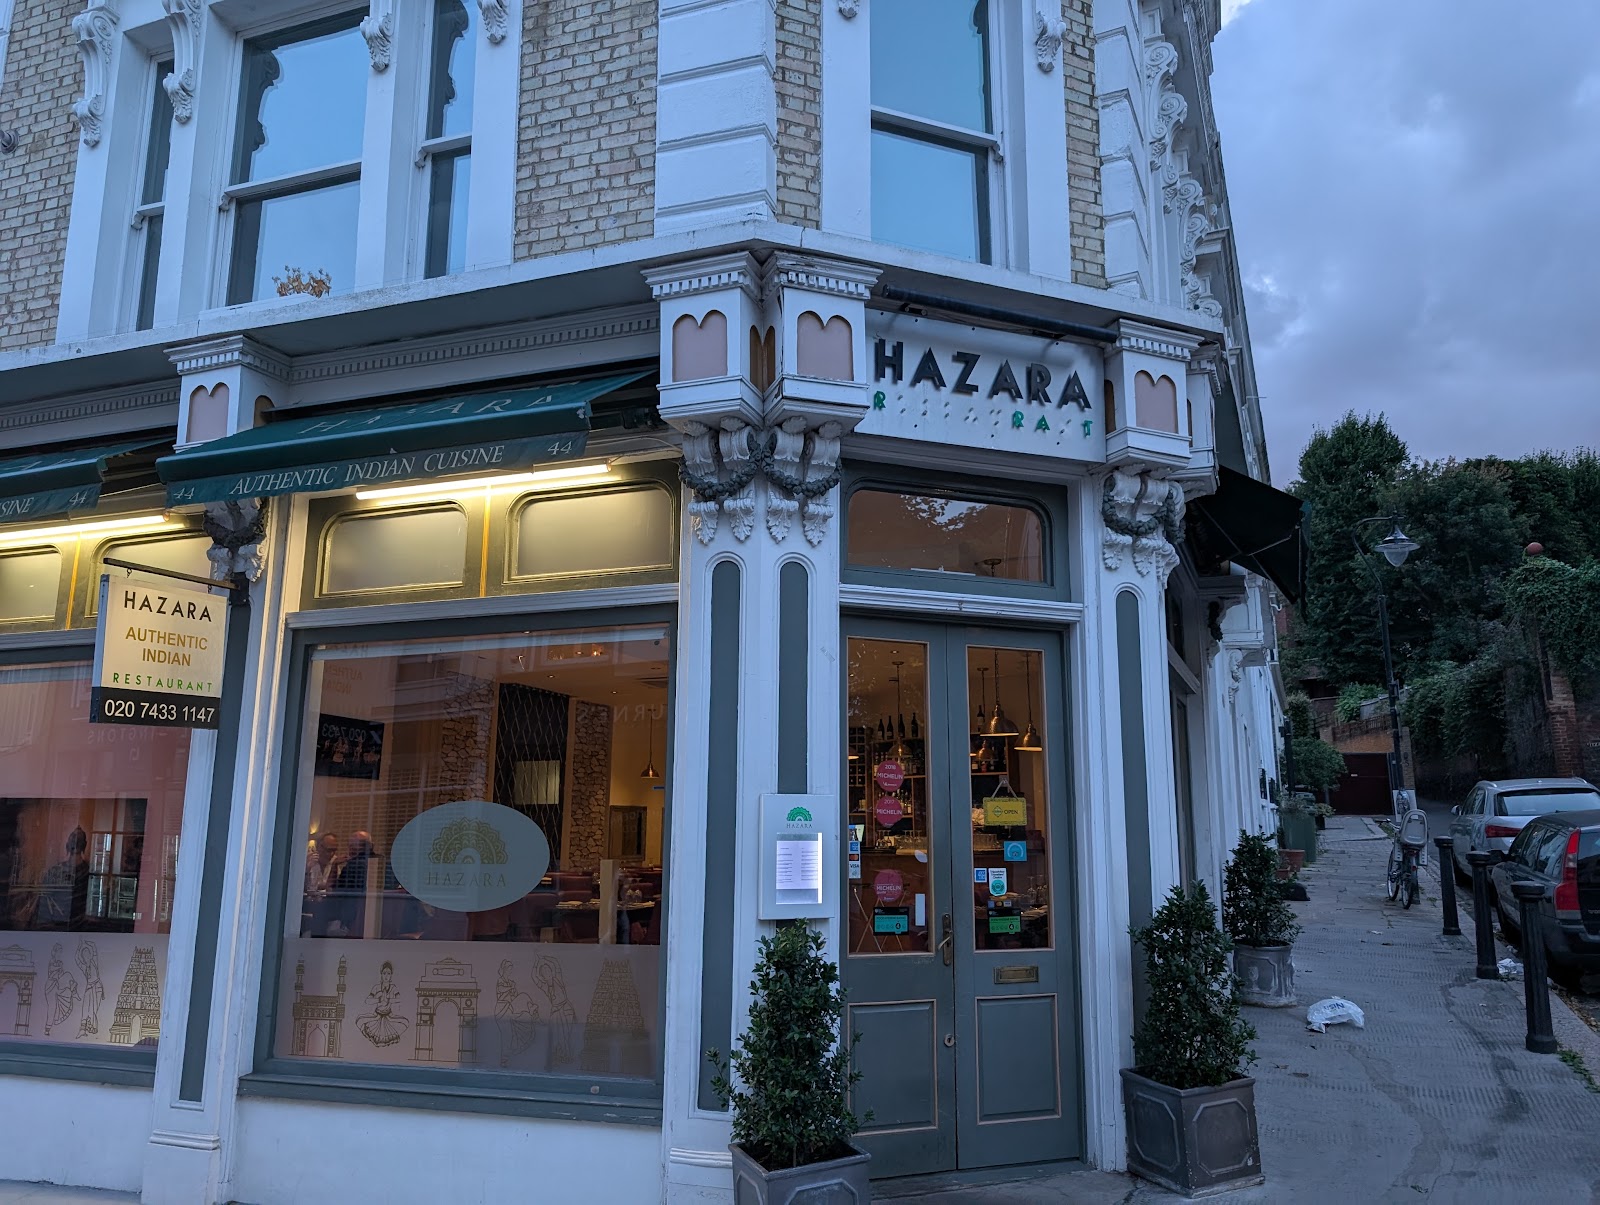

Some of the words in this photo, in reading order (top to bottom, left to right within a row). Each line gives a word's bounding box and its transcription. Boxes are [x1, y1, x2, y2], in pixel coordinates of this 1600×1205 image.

[874, 338, 1092, 411] HAZARA
[173, 487, 194, 500] 44
[229, 466, 338, 495] AUTHENTIC
[344, 457, 416, 482] INDIAN
[423, 445, 505, 472] CUISINE
[547, 440, 572, 456] 44
[0, 497, 34, 517] SINE
[69, 491, 88, 506] 44
[123, 590, 212, 622] HAZARA
[125, 626, 208, 650] AUTHENTIC
[142, 648, 191, 667] INDIAN
[112, 672, 213, 693] RESTAURANT
[104, 699, 135, 718] 020
[140, 702, 177, 721] 7433
[182, 705, 215, 722] 1147
[877, 772, 904, 780] MICHELIN
[876, 808, 902, 816] MICHELIN
[426, 872, 506, 888] HAZARA
